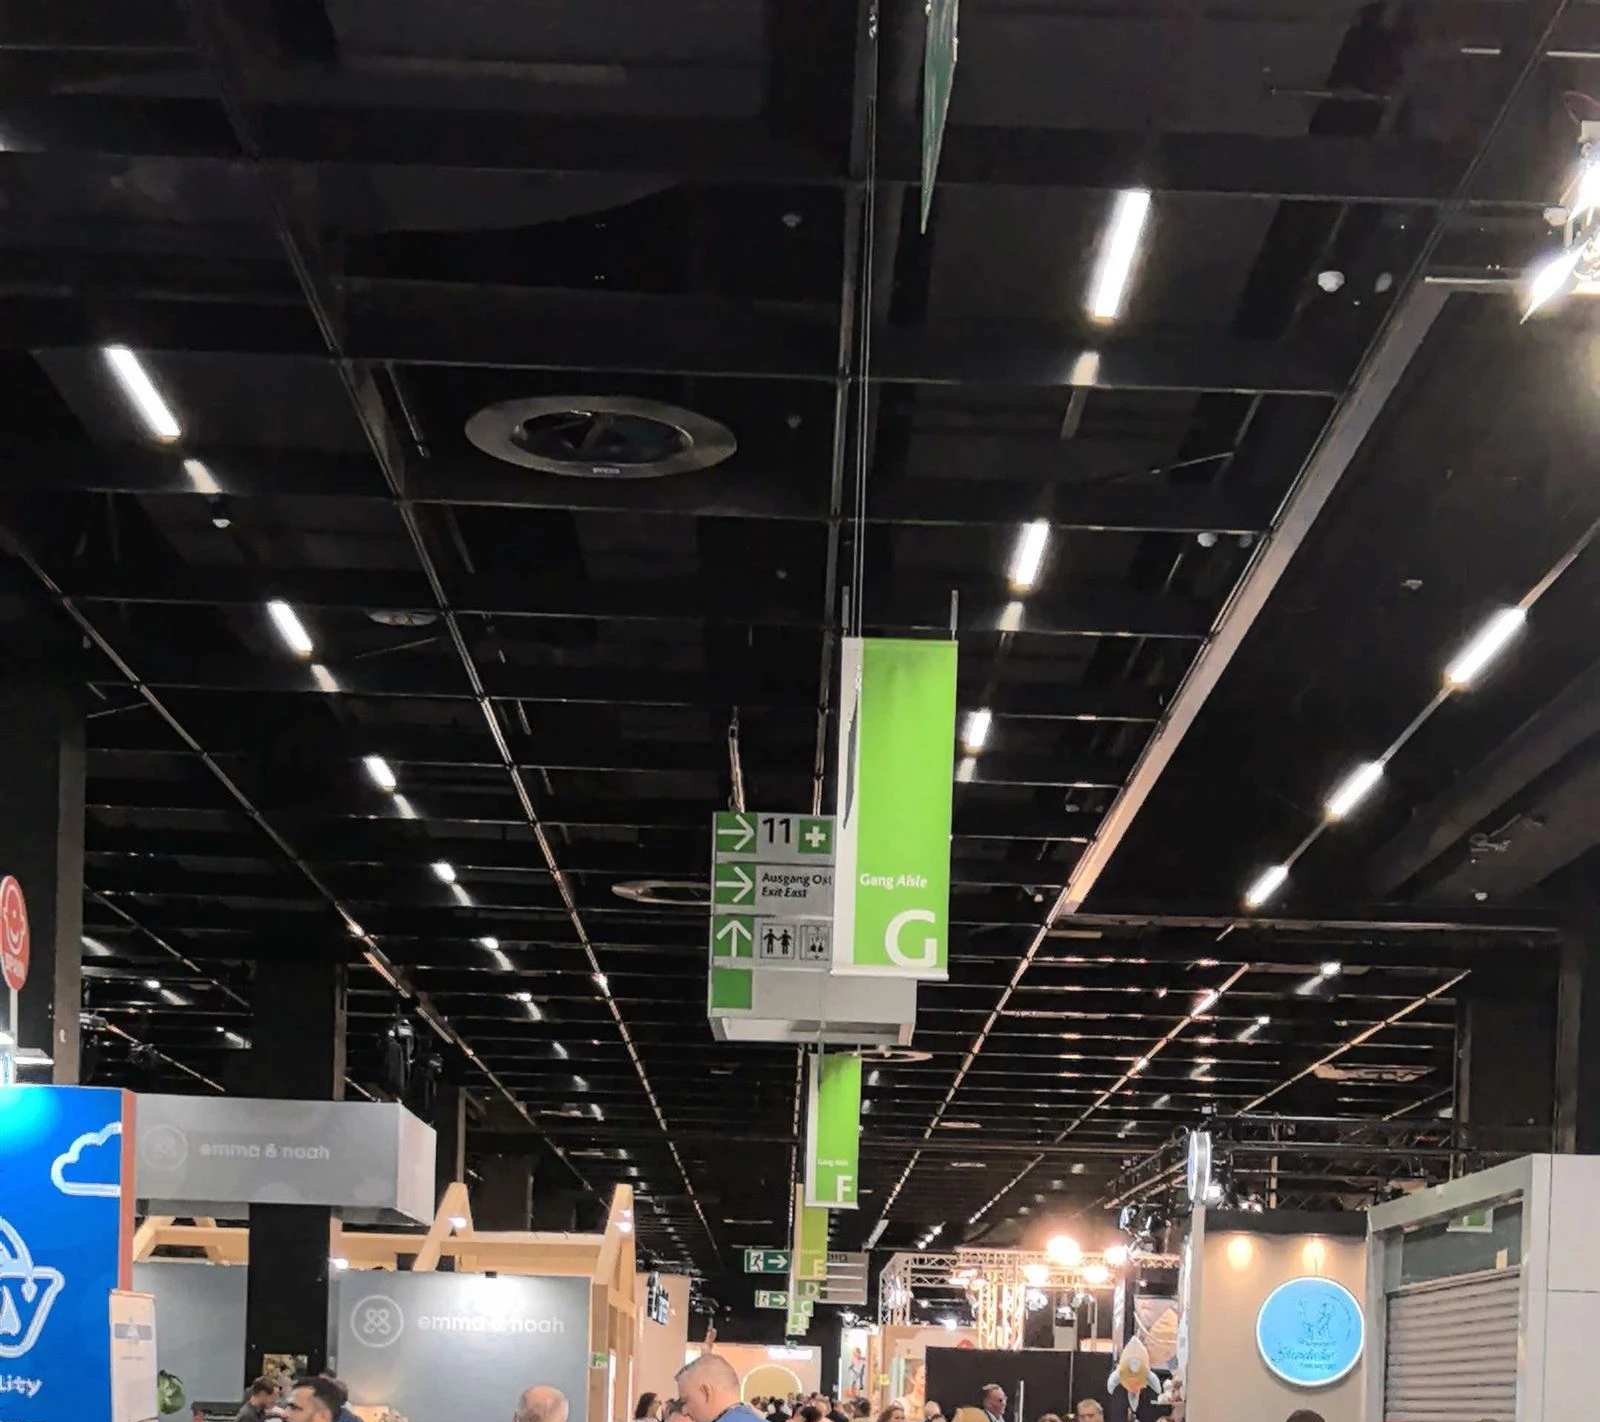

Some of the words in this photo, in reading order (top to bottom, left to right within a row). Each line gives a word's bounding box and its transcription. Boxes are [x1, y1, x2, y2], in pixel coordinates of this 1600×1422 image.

[762, 817, 791, 844] 11
[762, 872, 810, 887] Ausgang
[860, 873, 894, 890] Gang
[897, 874, 928, 888] Aisle
[762, 886, 783, 897] Exit
[784, 887, 807, 898] East
[885, 909, 938, 968] G
[200, 1143, 260, 1157] emma
[282, 1145, 330, 1160] noah
[836, 1175, 853, 1203] F
[813, 1259, 826, 1277] E
[805, 1281, 819, 1297] D
[418, 1315, 485, 1331] emma
[511, 1316, 564, 1333] noah
